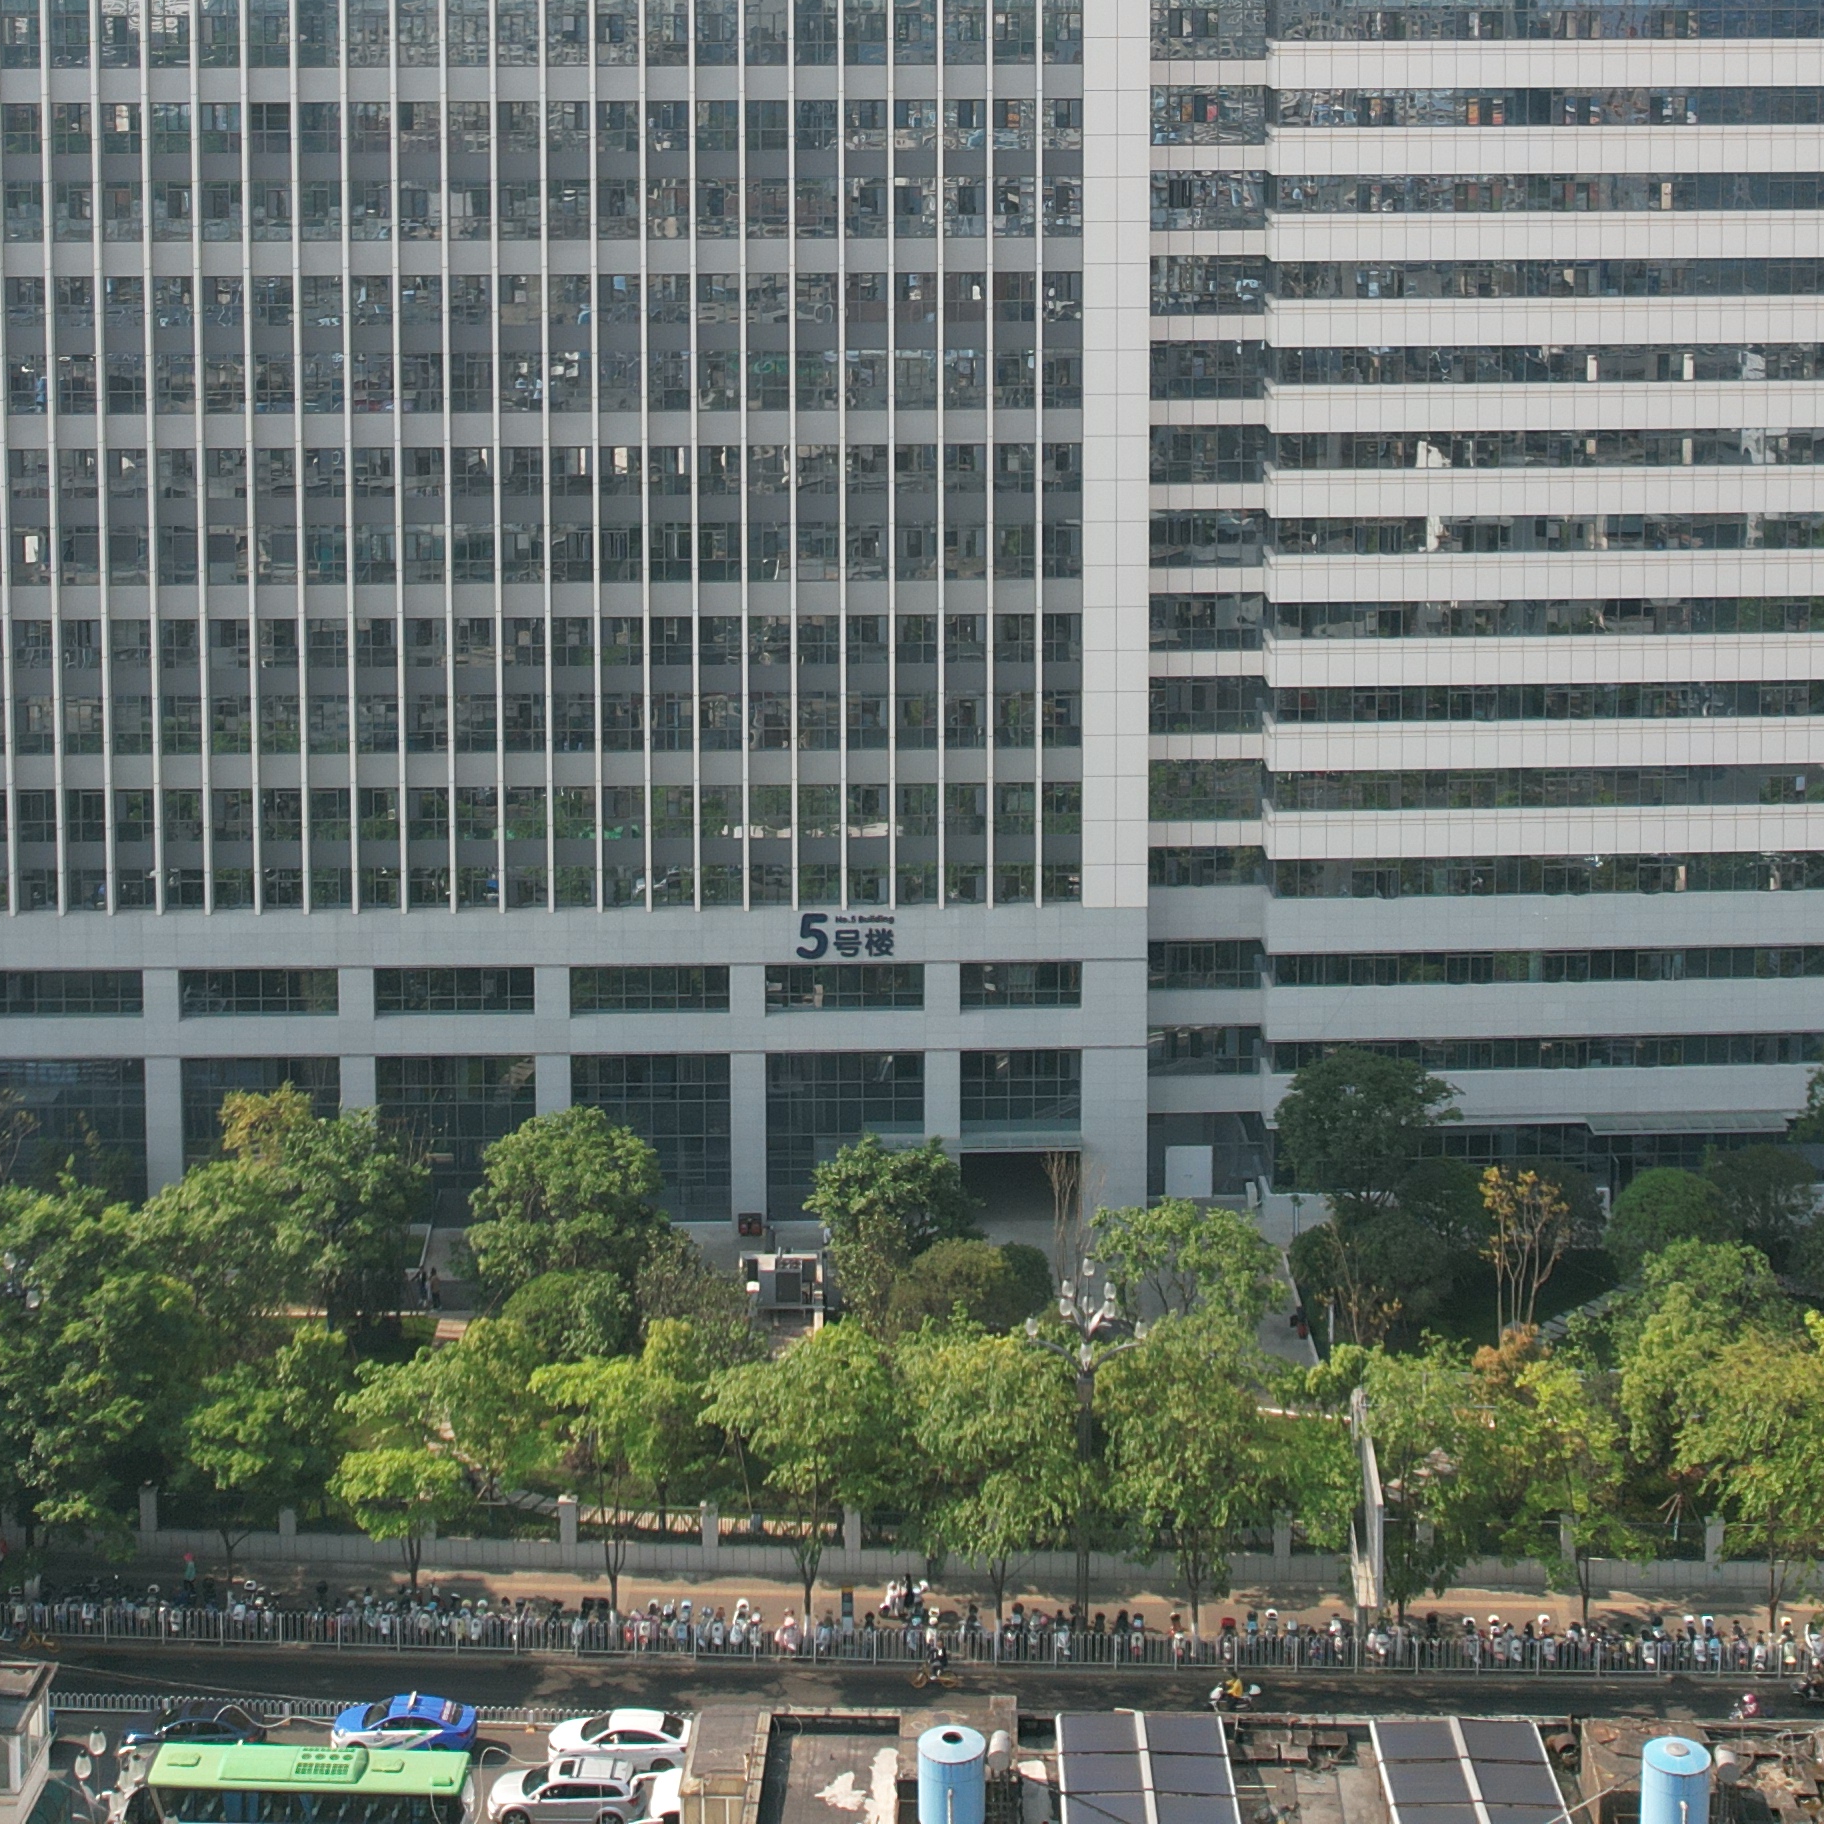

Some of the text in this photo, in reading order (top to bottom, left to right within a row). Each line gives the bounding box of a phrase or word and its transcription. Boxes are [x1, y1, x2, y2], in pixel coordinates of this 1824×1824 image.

[835, 914, 895, 925] No.5 Building
[796, 913, 895, 959] 5号楼
